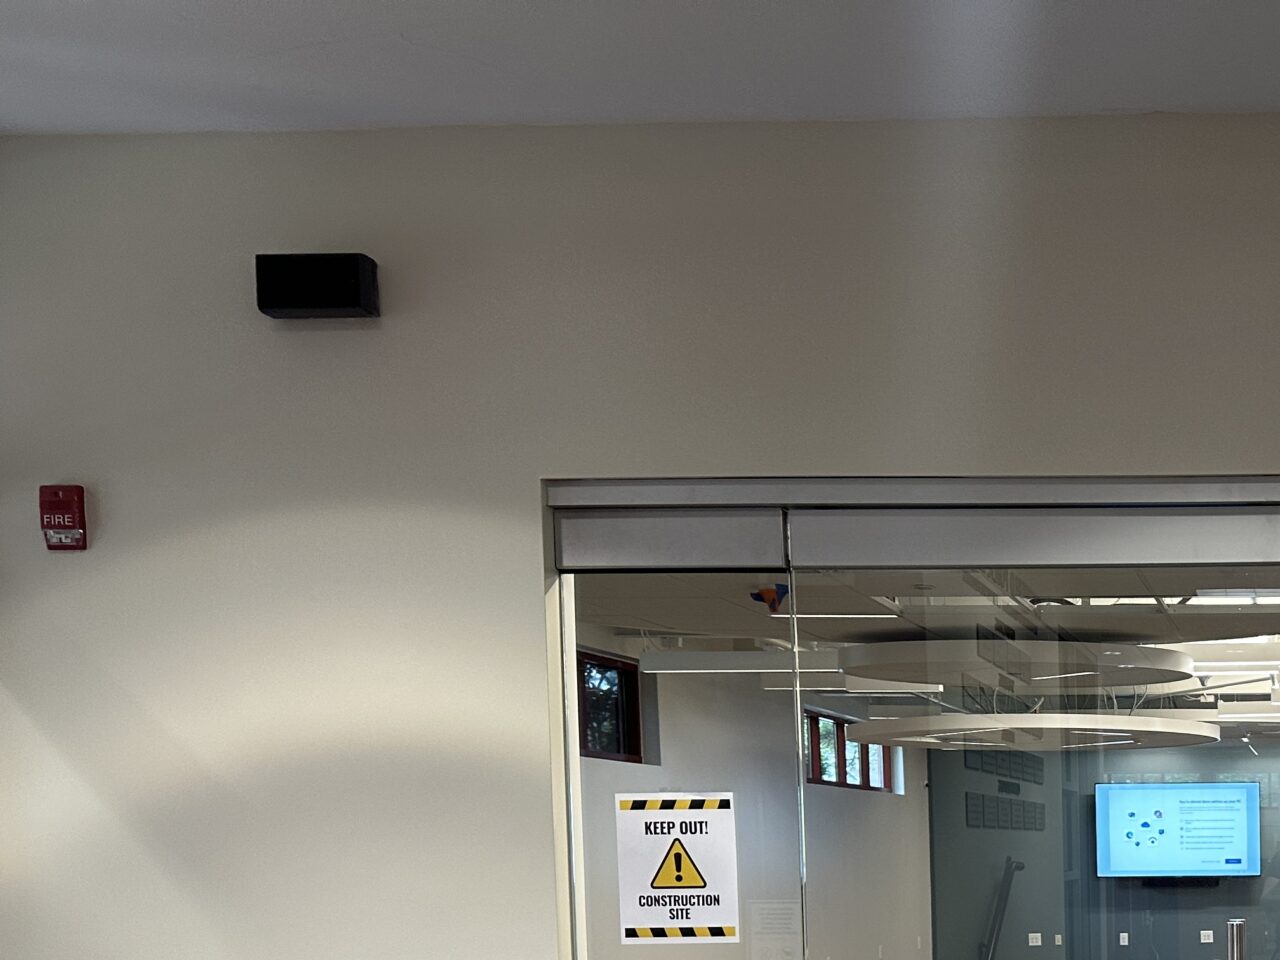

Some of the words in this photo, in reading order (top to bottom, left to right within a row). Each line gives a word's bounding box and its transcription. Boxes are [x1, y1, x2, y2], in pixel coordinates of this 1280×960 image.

[43, 514, 73, 525] FIRE
[644, 821, 675, 835] KEEP
[679, 820, 709, 835] OUT!
[638, 894, 720, 907] CONSTRUCTION
[668, 908, 691, 920] SITE
